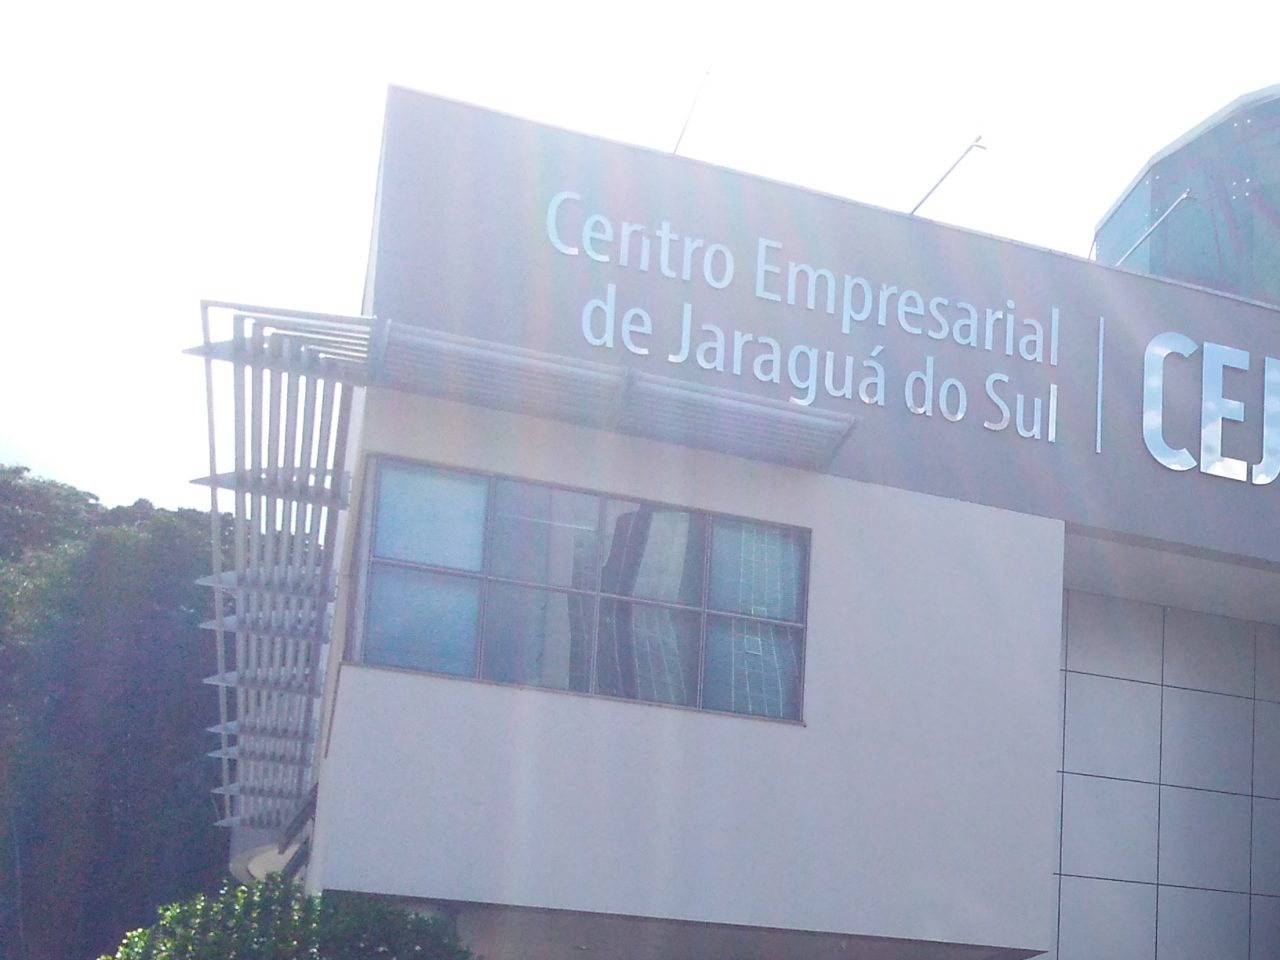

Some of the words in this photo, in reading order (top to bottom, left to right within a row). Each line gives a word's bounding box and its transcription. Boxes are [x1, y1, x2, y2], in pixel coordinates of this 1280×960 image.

[546, 190, 735, 290] Centro
[755, 237, 1060, 366] Empresarial
[581, 284, 653, 356] de
[667, 302, 886, 407] Jaraguá
[904, 355, 967, 423] do
[983, 372, 1058, 443] Sul
